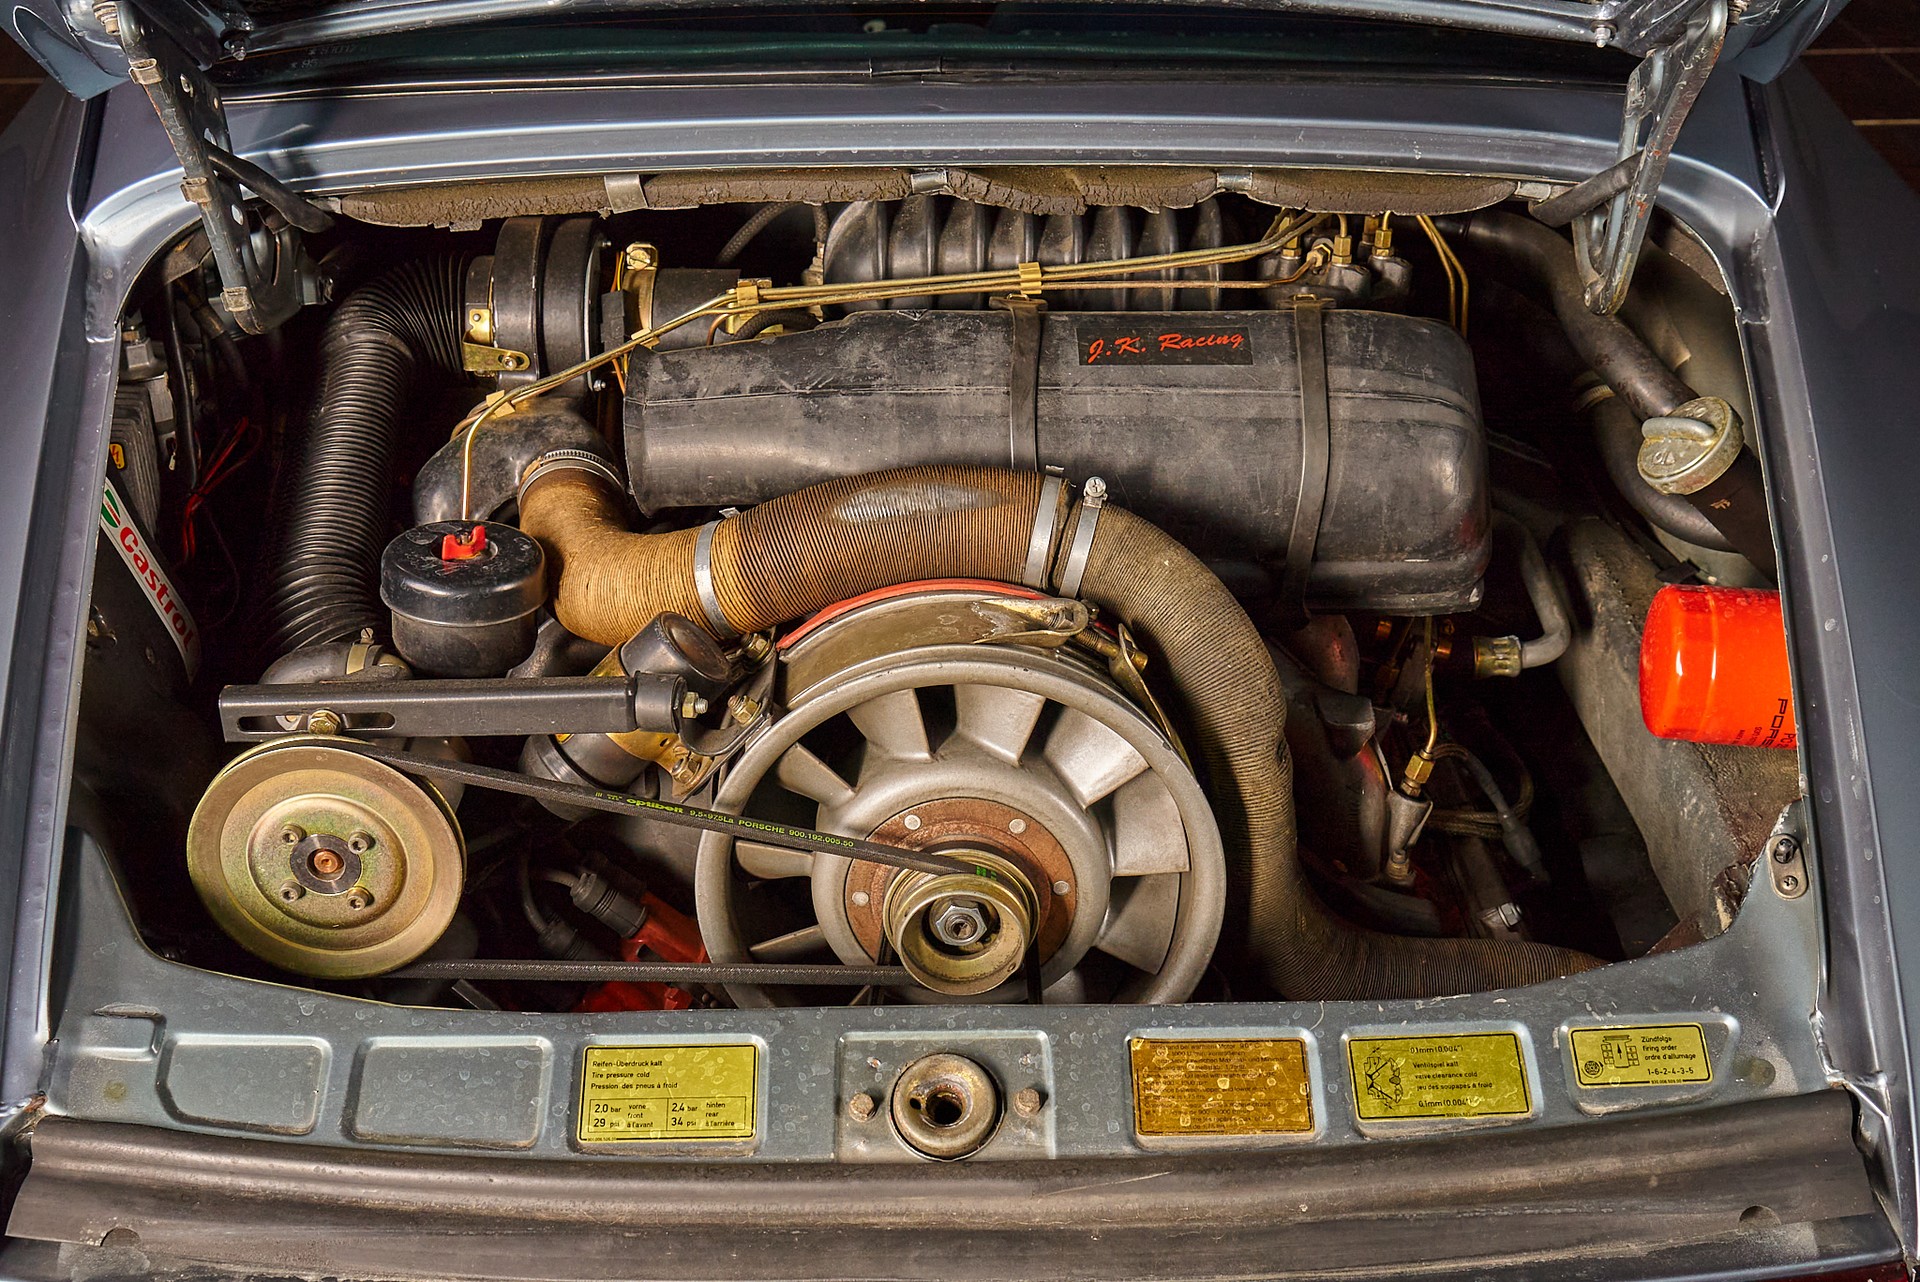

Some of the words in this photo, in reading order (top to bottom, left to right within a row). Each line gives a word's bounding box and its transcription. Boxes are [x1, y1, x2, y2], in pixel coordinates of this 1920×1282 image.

[1087, 337, 1146, 364] J.K.
[1157, 333, 1245, 352] Racing
[120, 527, 194, 650] Castrol
[738, 819, 785, 834] PORSCHE
[788, 829, 854, 848] 900.192.005.50
[1647, 1067, 1694, 1075] 1-6-2-4-3-5
[593, 1118, 606, 1128] 29
[671, 1117, 684, 1127] 34
